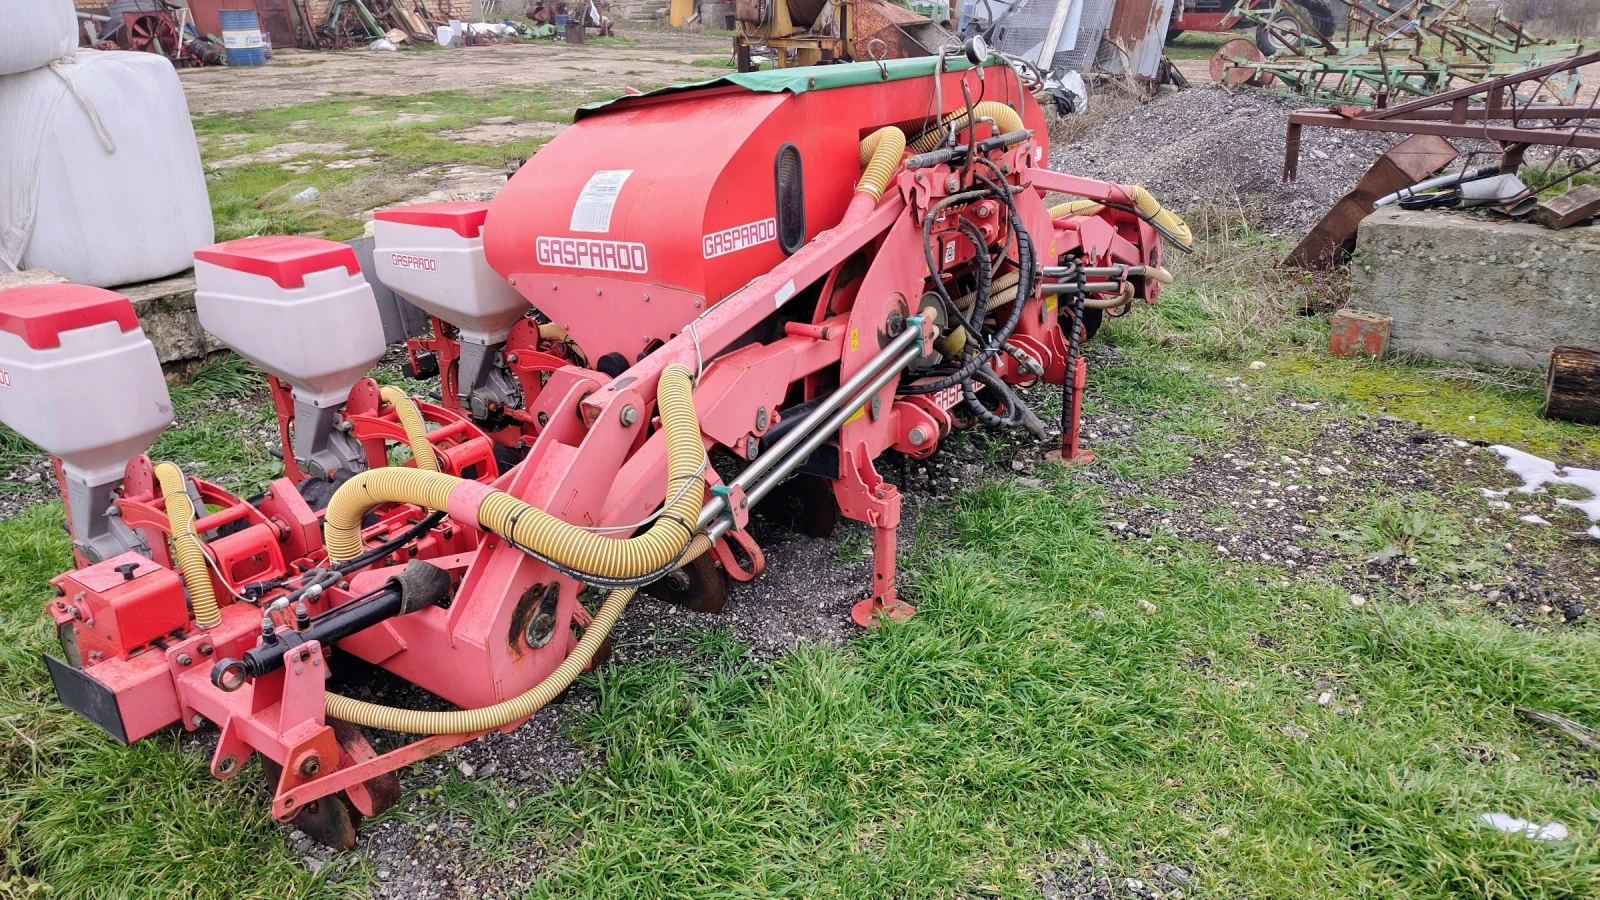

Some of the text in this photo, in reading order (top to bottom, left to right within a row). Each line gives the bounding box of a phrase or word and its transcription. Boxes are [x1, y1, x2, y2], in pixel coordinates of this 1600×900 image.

[537, 238, 646, 271] GASPARDO
[703, 219, 776, 257] GASPARDO
[391, 253, 437, 271] GASPARDO
